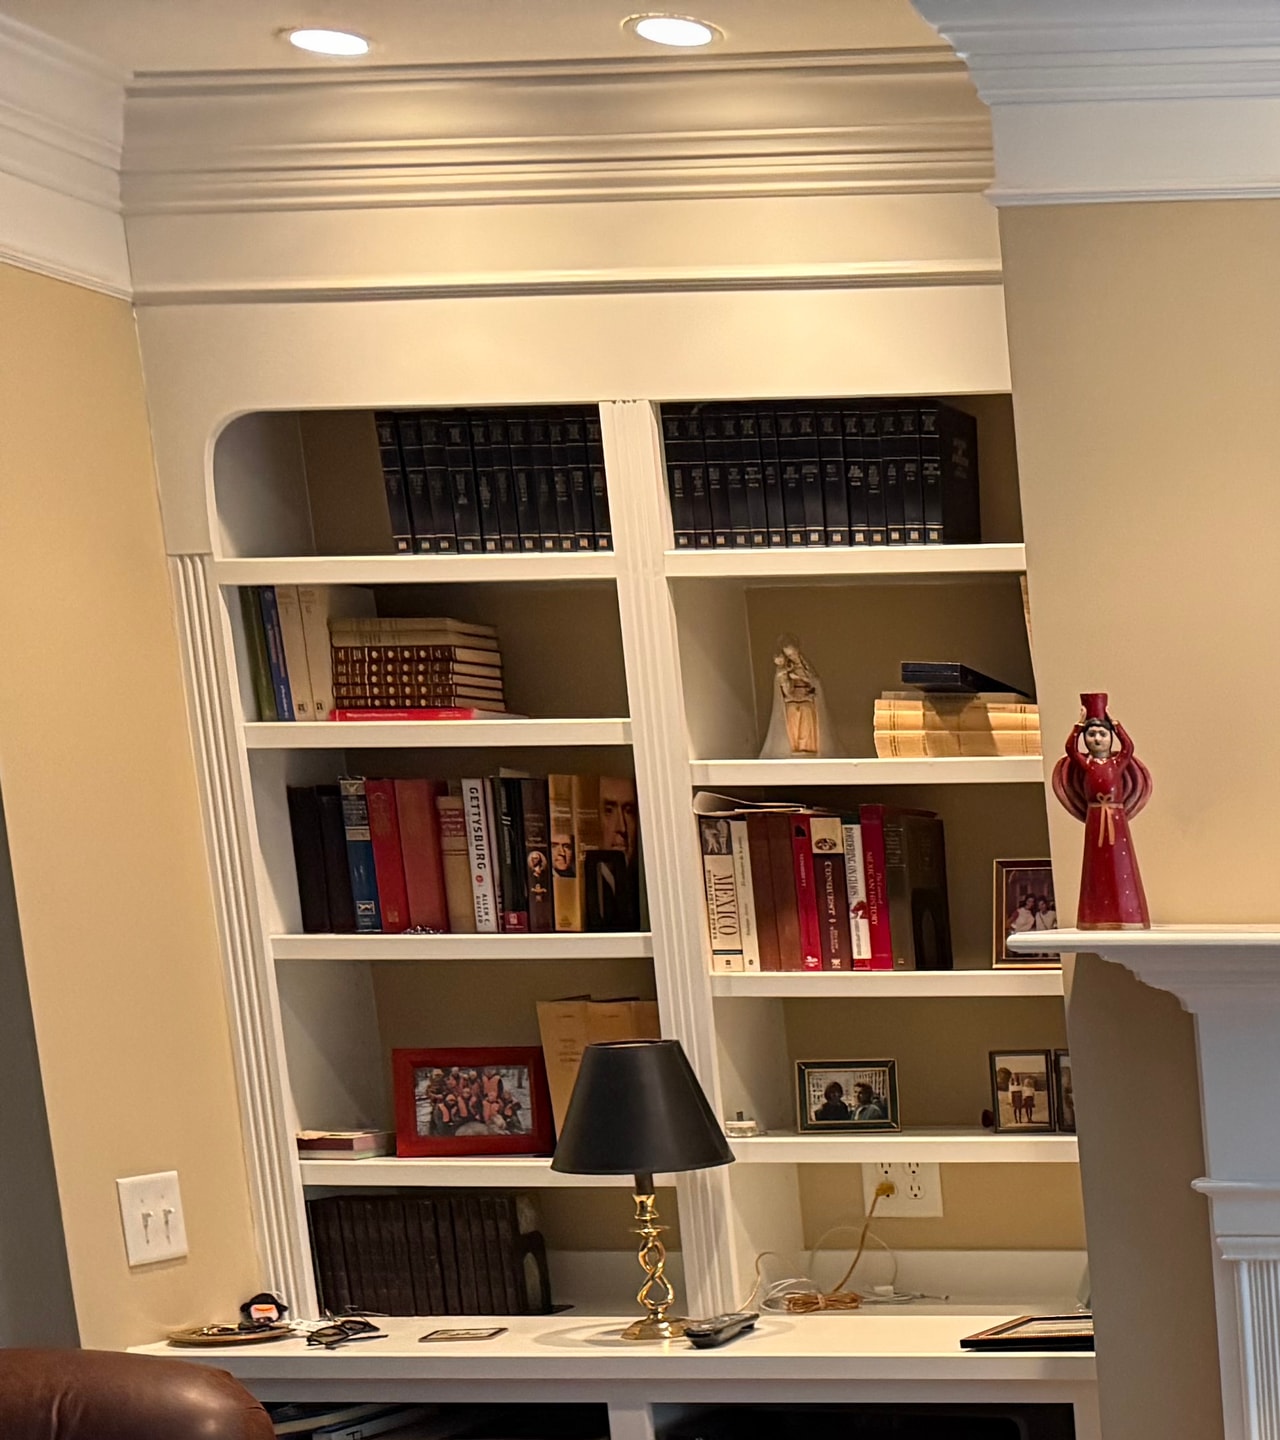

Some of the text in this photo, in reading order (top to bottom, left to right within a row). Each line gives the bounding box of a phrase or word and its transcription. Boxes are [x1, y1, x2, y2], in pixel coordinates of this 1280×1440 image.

[469, 786, 487, 871] GETTYSBURG
[844, 826, 857, 865] BORDERING
[707, 869, 716, 907] BIOGRAPHY
[823, 860, 837, 916] CONQUEST
[847, 874, 859, 898] CHAOS
[865, 851, 876, 890] MEXICAN
[482, 893, 491, 916] ALLEN
[712, 873, 738, 936] MEXICO
[868, 891, 878, 926] HISTORY
[709, 917, 718, 940] POWER
